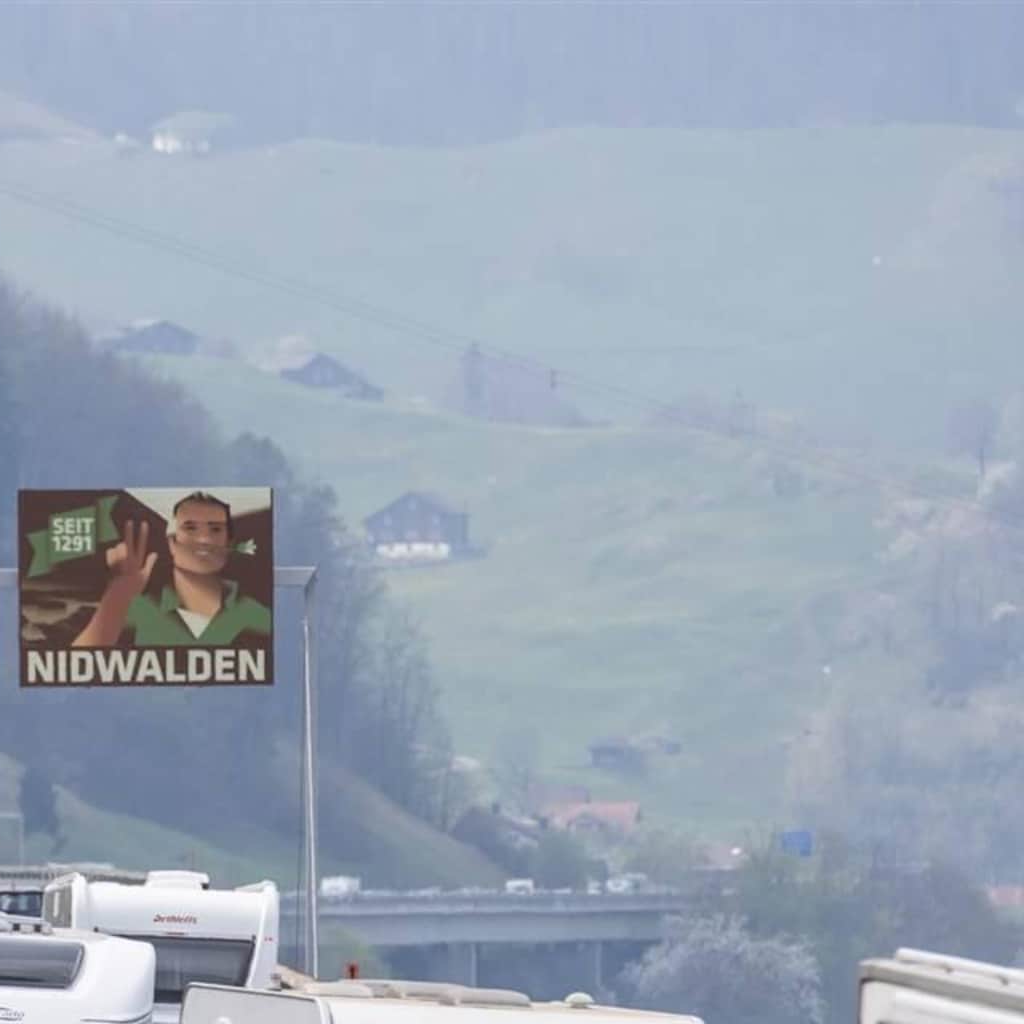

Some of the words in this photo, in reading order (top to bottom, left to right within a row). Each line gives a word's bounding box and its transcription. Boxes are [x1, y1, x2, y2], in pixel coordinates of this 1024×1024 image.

[52, 517, 95, 535] SEIT
[51, 535, 92, 552] 1291
[27, 649, 266, 683] NIDWALDEN
